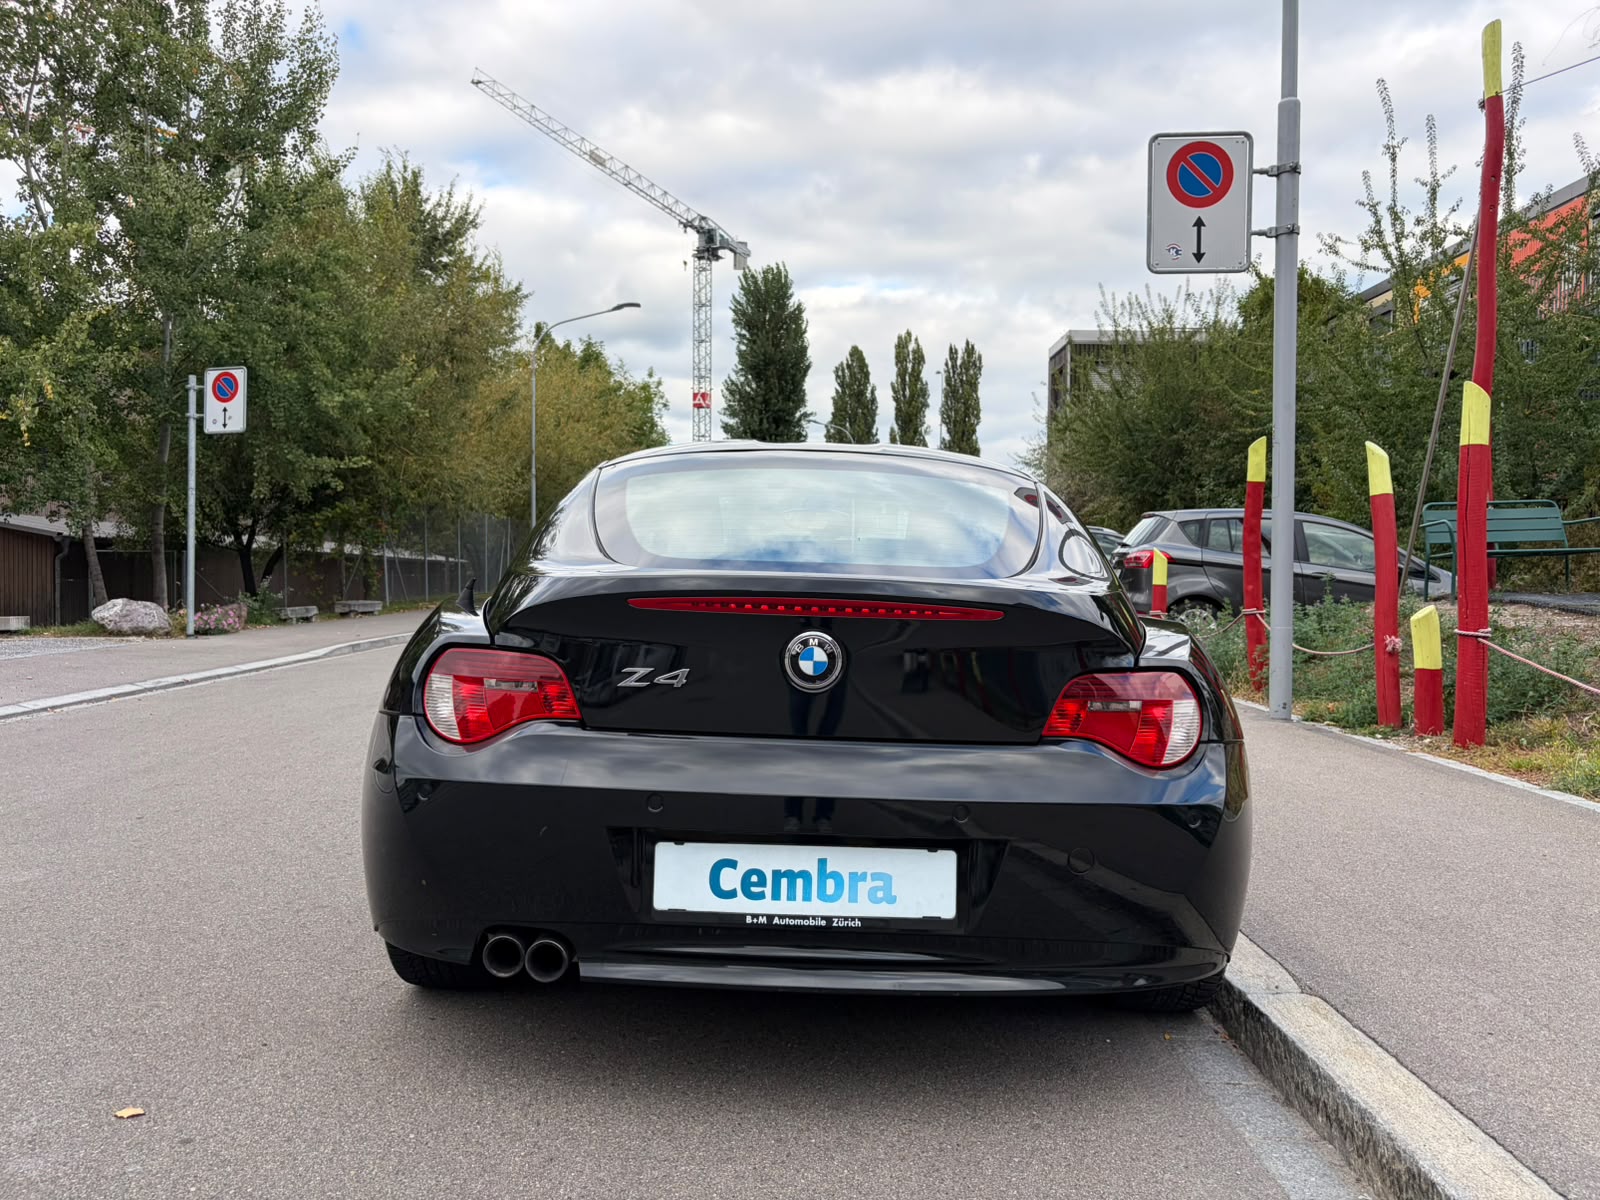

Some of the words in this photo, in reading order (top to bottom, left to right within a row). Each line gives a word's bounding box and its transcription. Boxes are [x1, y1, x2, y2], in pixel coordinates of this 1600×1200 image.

[794, 638, 834, 654] BMW
[616, 667, 690, 688] Z4
[708, 857, 897, 905] Cembra
[745, 915, 767, 924] B+M
[772, 916, 827, 926] Automobile
[832, 918, 862, 927] Zürich
